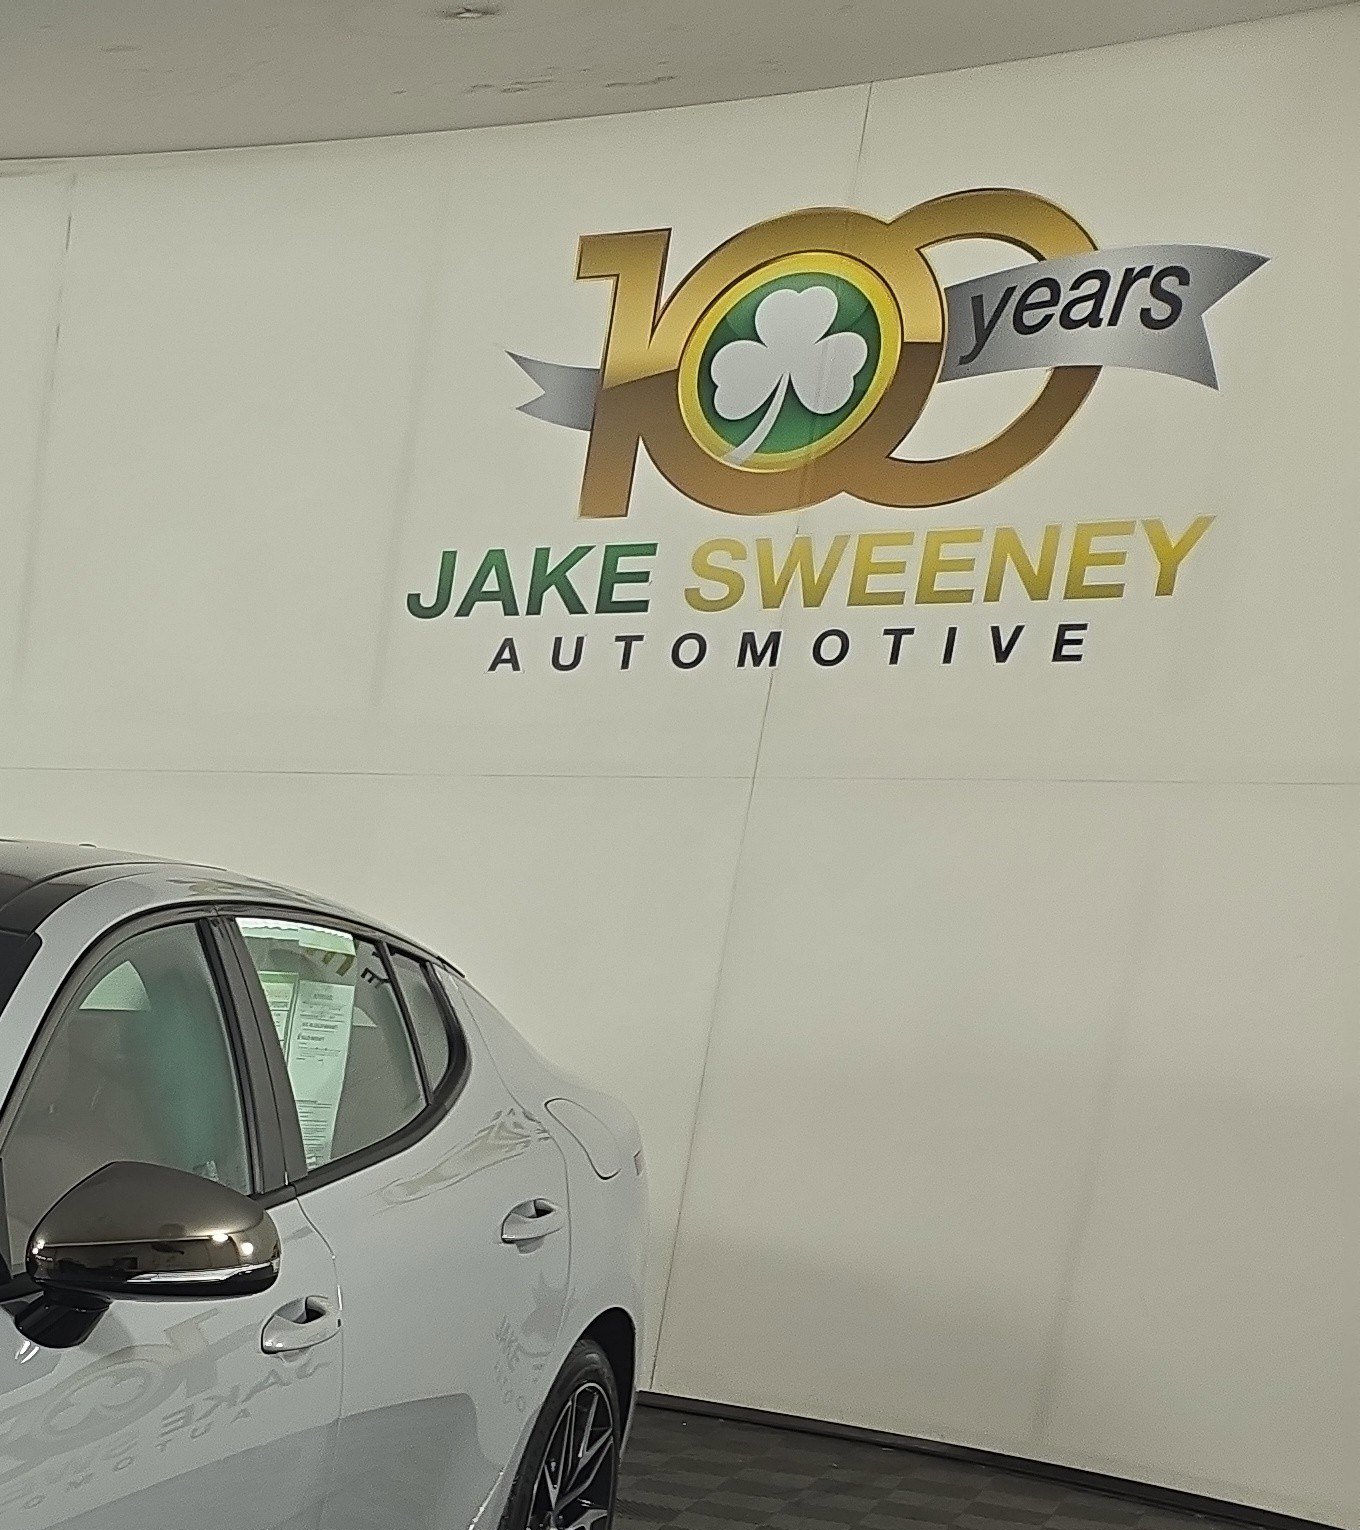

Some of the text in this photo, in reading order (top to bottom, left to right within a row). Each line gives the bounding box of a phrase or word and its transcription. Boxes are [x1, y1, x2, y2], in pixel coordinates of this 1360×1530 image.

[958, 263, 1191, 365] years
[406, 514, 1216, 620] JAKE SWEENEY
[488, 622, 1090, 674] AUTOMOTIVE
